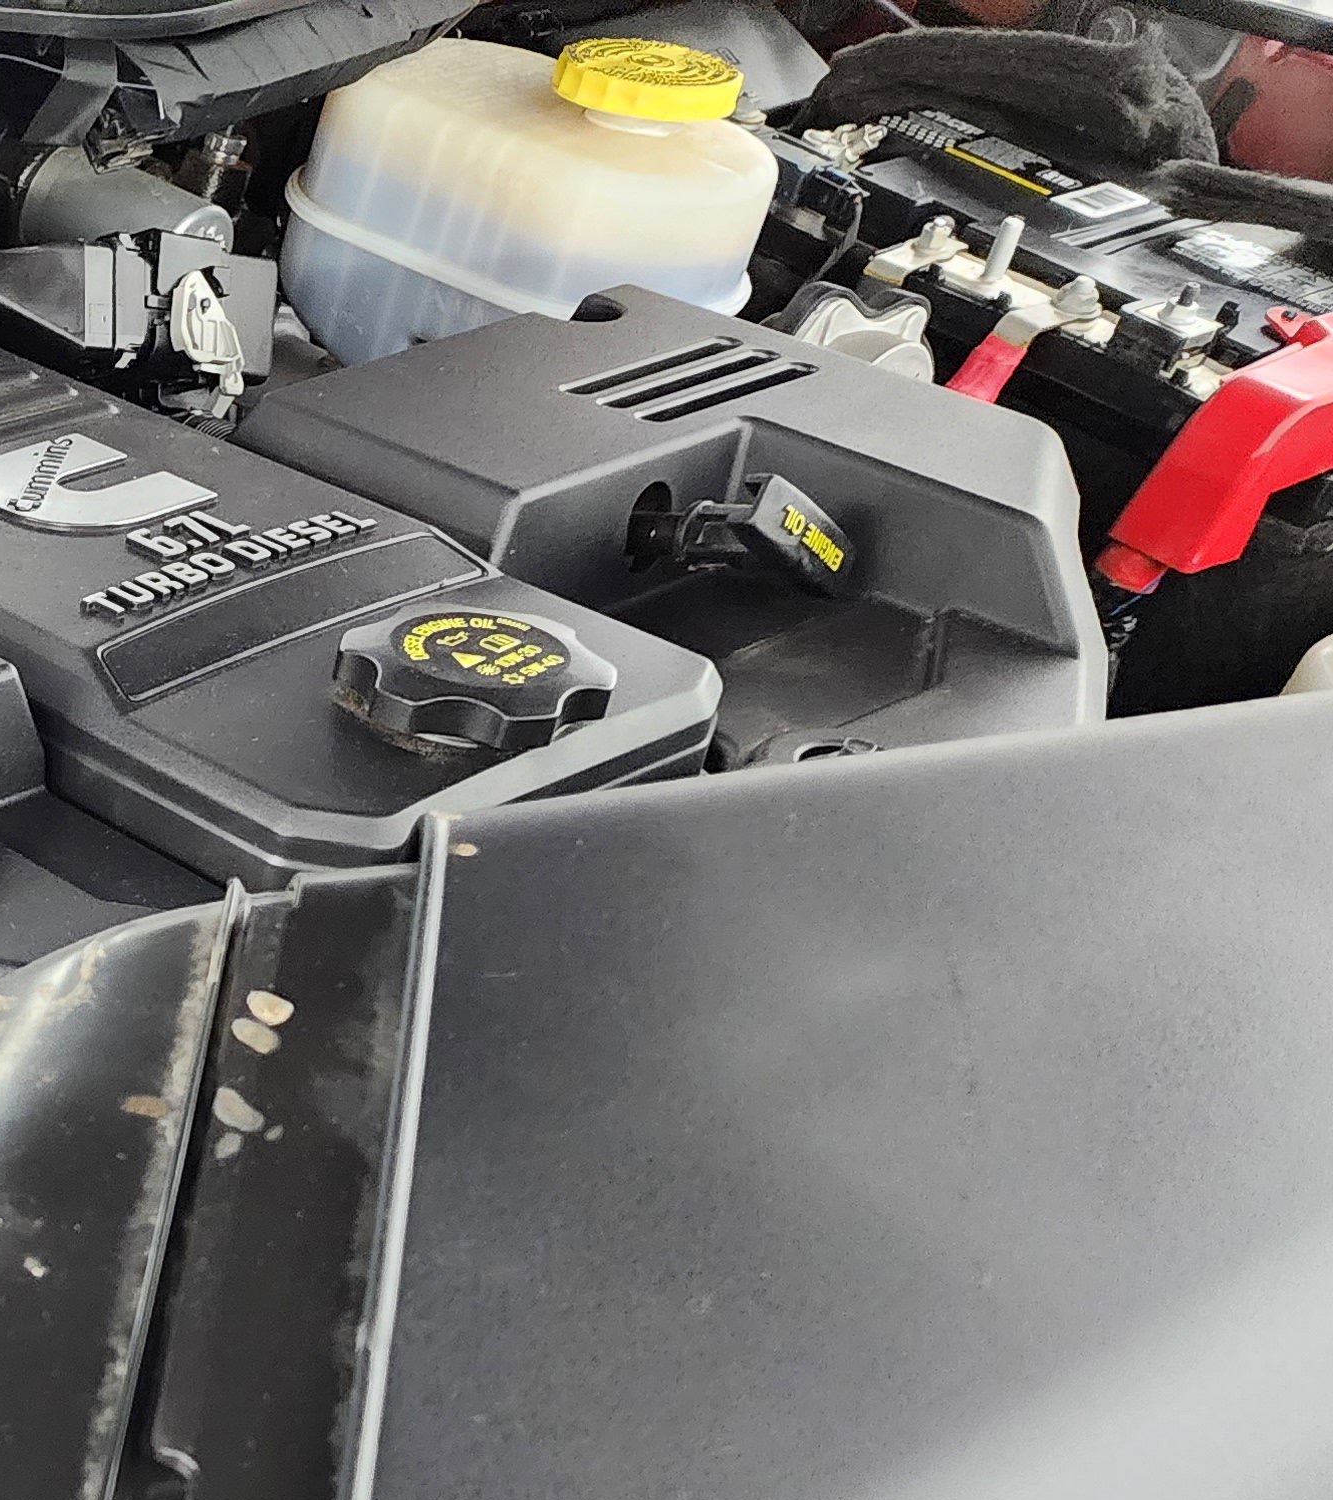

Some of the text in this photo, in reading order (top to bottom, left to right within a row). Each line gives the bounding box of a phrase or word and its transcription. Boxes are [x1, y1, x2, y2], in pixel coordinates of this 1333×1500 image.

[6, 438, 73, 512] Cummins
[81, 510, 379, 620] TURBO DIESEL
[126, 510, 251, 561] 6.7L
[784, 504, 845, 572] ENGINE OIL
[412, 617, 468, 637] ENGINE
[469, 617, 498, 630] OIL
